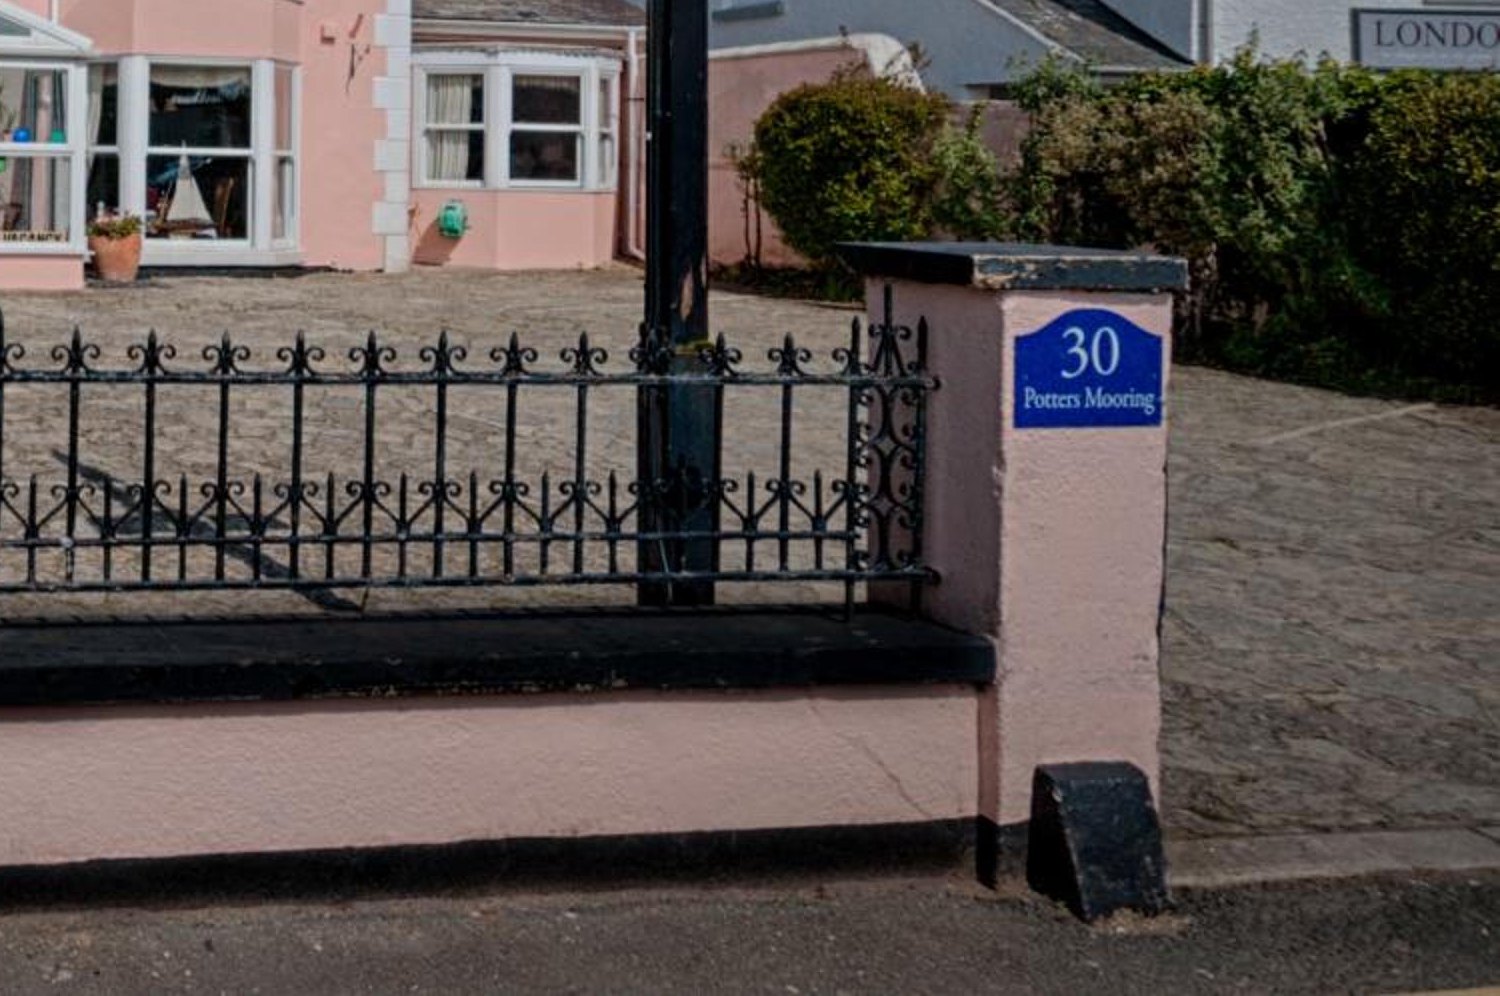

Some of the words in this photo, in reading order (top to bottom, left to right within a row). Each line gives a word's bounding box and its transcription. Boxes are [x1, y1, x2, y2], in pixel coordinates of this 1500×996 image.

[1060, 326, 1120, 379] 30
[1023, 386, 1080, 409] Potters
[1084, 385, 1156, 415] Mooring
